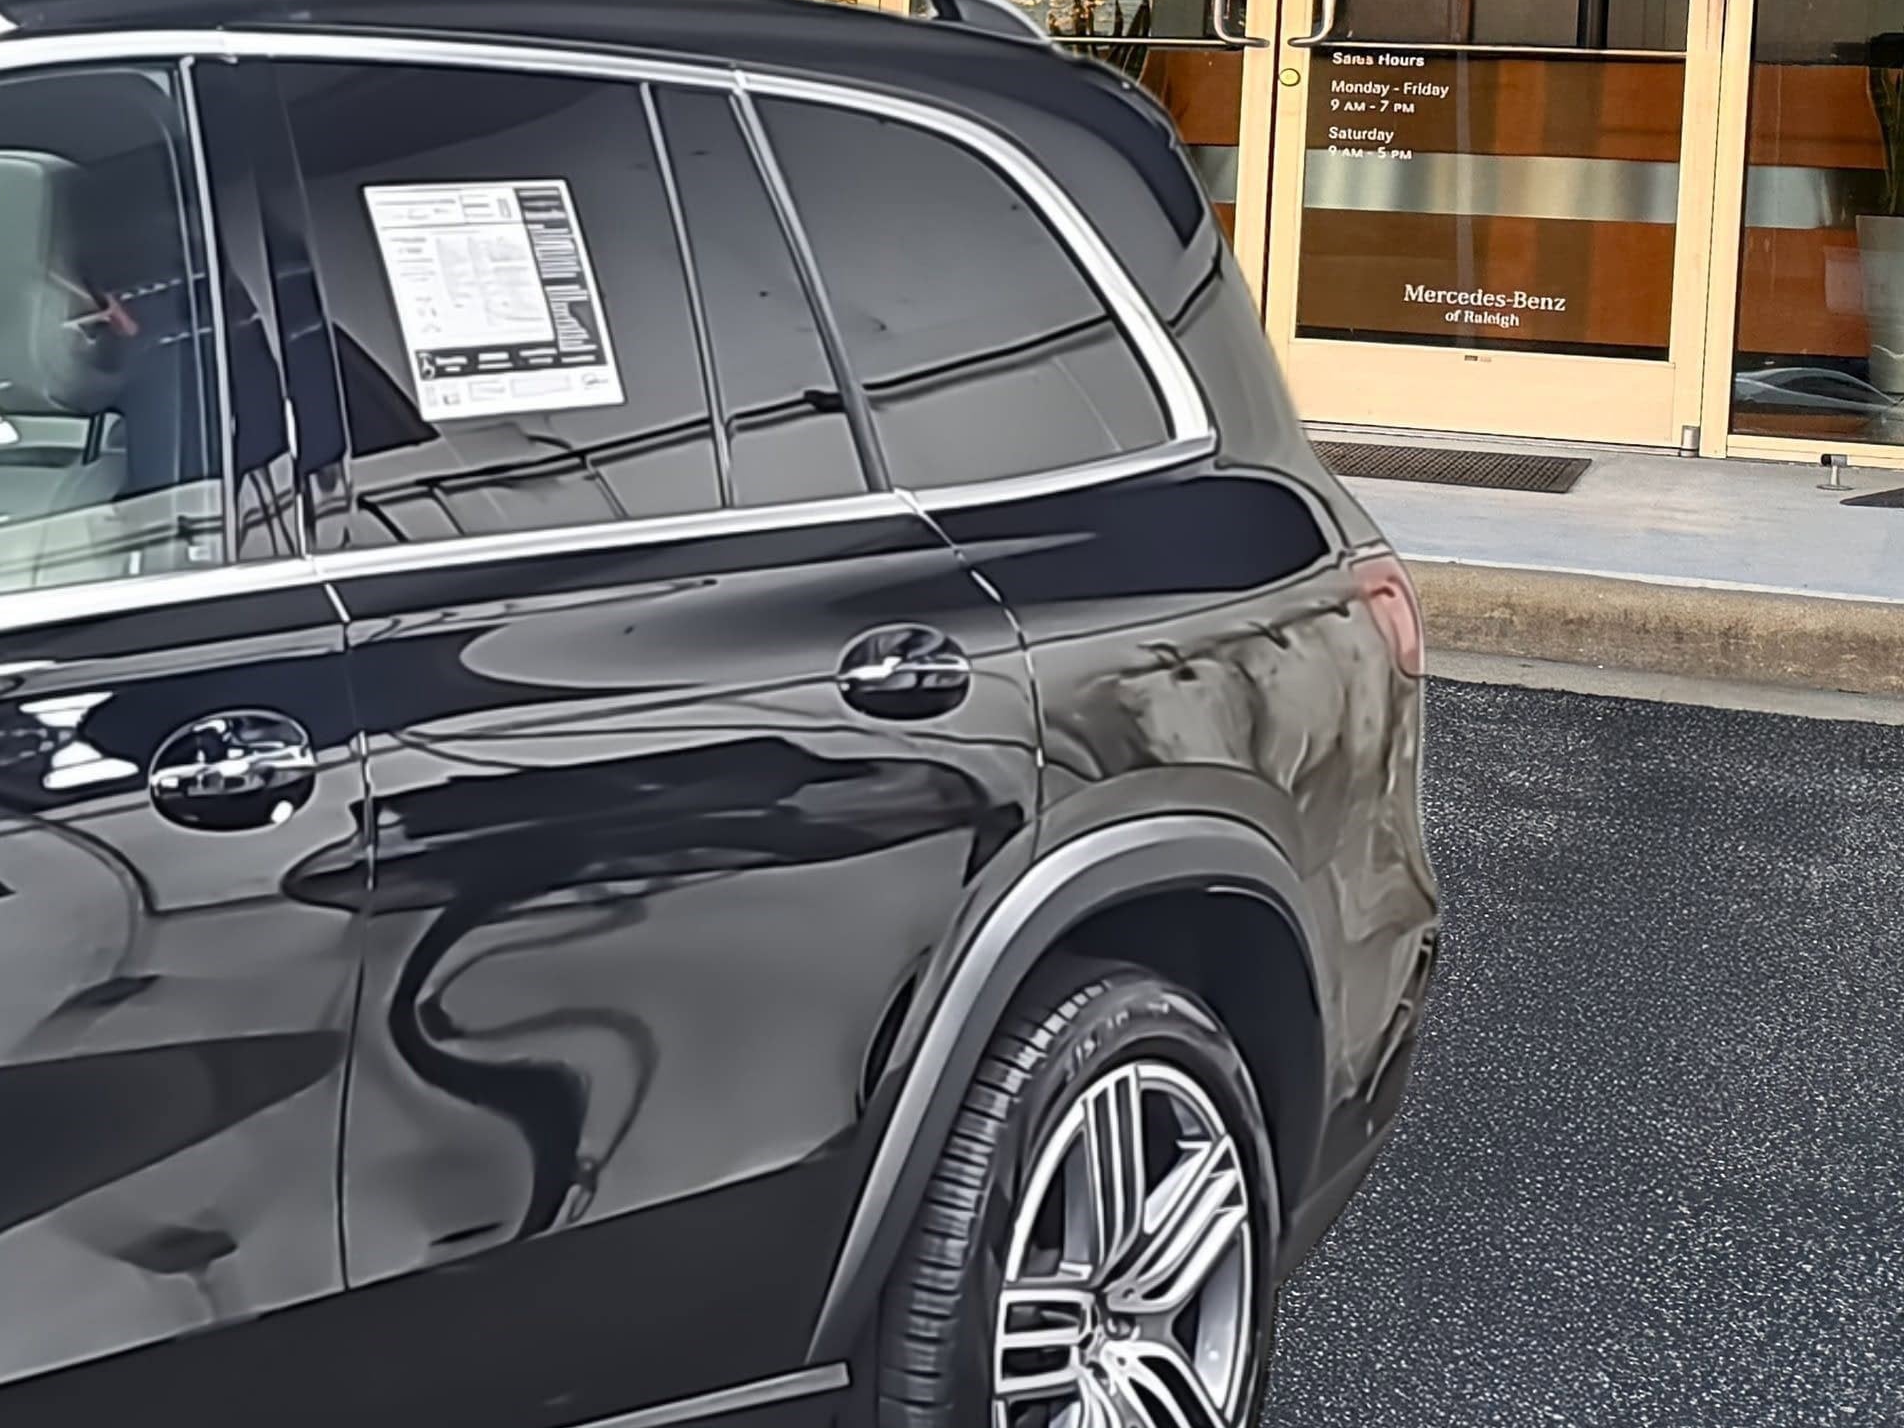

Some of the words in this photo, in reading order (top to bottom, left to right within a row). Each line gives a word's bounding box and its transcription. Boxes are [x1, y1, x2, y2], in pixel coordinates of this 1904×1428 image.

[1378, 53, 1425, 67] Hours
[1331, 80, 1390, 97] Monday
[1403, 82, 1449, 98] Friday
[1330, 99, 1340, 111] 9
[1344, 102, 1366, 111] AM
[1380, 100, 1389, 112] 7
[1394, 103, 1415, 113] PM
[1328, 126, 1394, 143] Saturday
[1328, 145, 1337, 157] 9
[1342, 148, 1363, 158] AM
[1377, 147, 1386, 158] 5
[1391, 149, 1412, 159] PM
[1403, 283, 1566, 311] Mercedes-Benz
[1445, 310, 1460, 322] of
[1464, 310, 1520, 328] Raleigh
